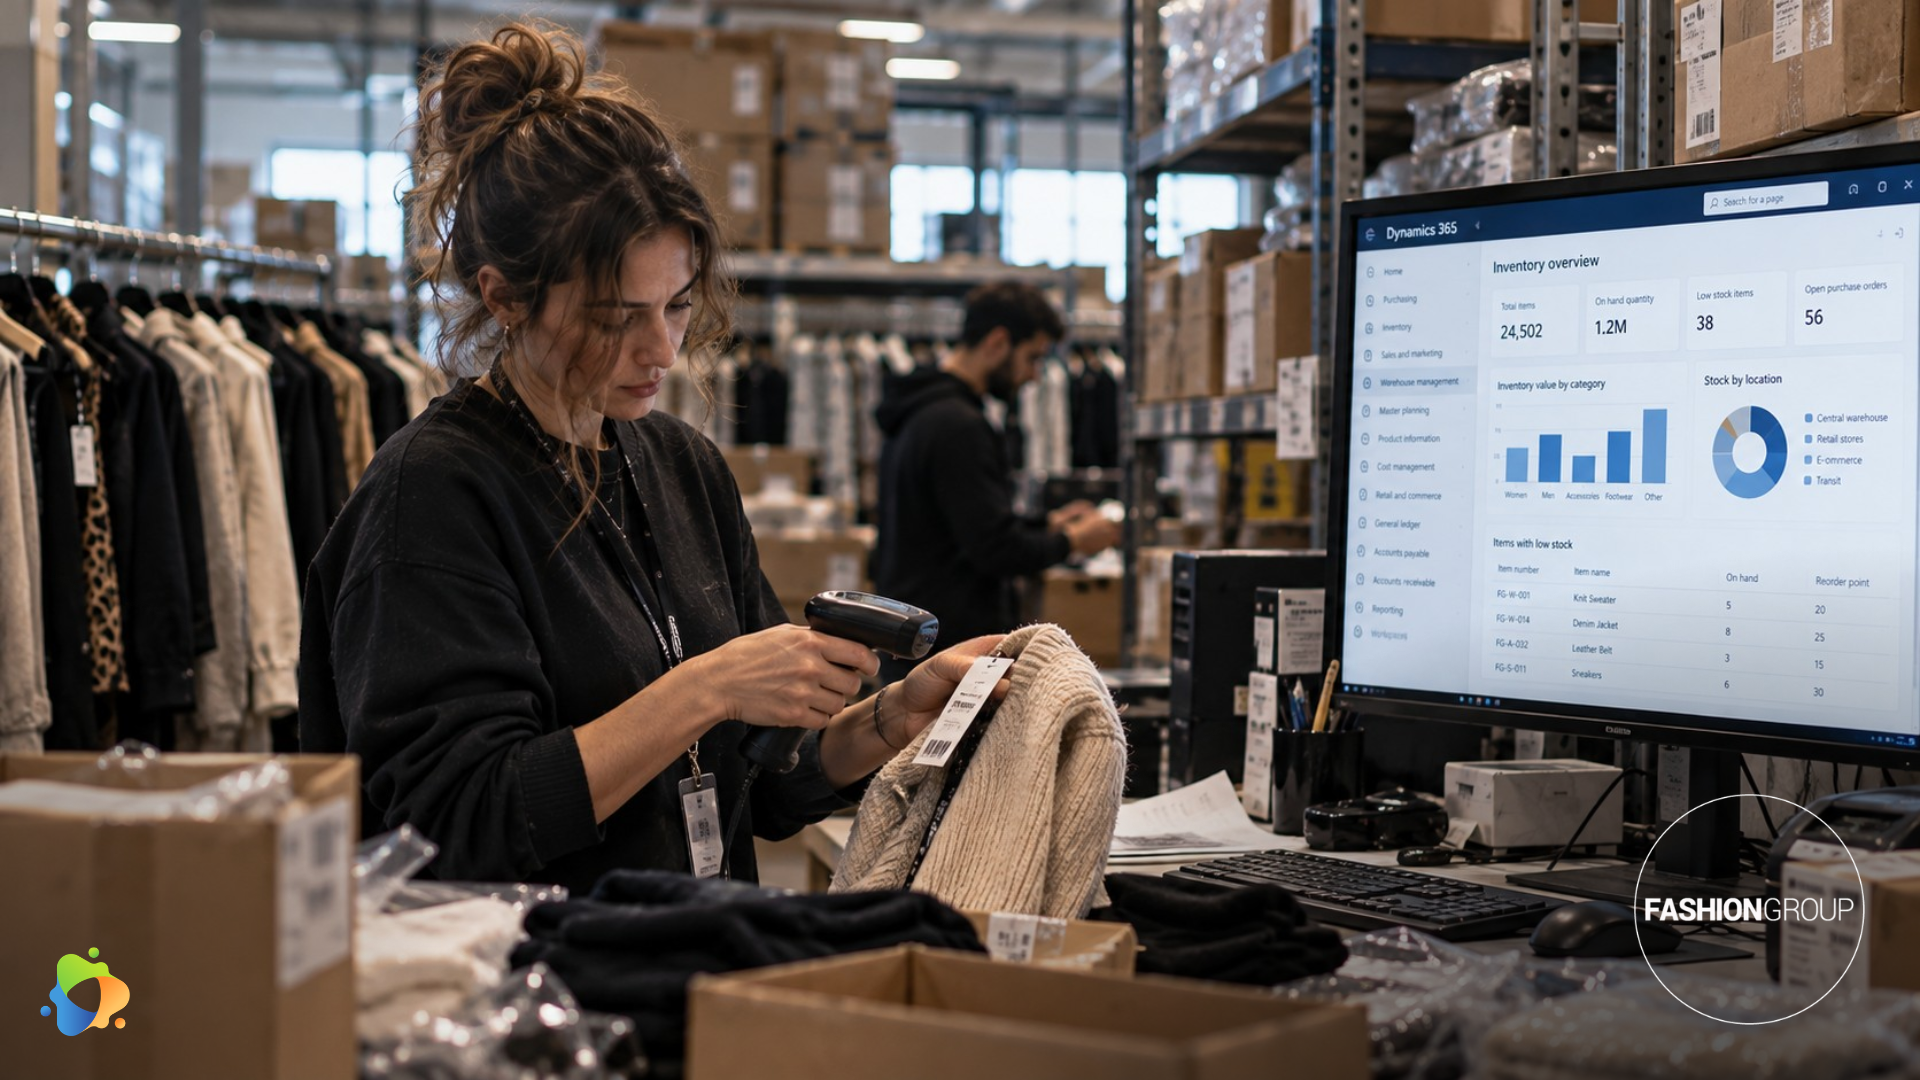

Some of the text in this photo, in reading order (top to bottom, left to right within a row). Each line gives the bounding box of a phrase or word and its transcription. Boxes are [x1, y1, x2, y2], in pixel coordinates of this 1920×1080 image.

[1748, 195, 1758, 205] for
[1765, 194, 1784, 205] page
[1386, 220, 1458, 242] Dynamics 365
[1492, 254, 1600, 274] Inventory overview
[1383, 267, 1403, 276] Home
[1804, 280, 1888, 295] Open purchase orders
[1382, 294, 1418, 305] Purchasing
[1696, 288, 1754, 300] Low stock items
[1594, 294, 1655, 306] On hand quantity
[1501, 301, 1536, 311] Total items
[1696, 314, 1714, 331] 38
[1804, 308, 1824, 326] 56
[1381, 323, 1413, 333] Inventory
[1500, 323, 1543, 341] 24,502
[1594, 319, 1628, 336] 1.2M
[1381, 348, 1443, 360] Sales and marketing
[1380, 377, 1459, 388] Warehouse management
[1497, 378, 1606, 392] Inventory value by category
[1703, 373, 1783, 387] Stock by location
[1401, 405, 1430, 417] planning
[1816, 412, 1889, 424] Central warehouse
[1378, 433, 1441, 443] Product information
[1816, 434, 1864, 444] Retail stores
[1377, 462, 1435, 474] Cost management
[1816, 475, 1842, 486] Transit
[1375, 490, 1442, 501] Retail and commerce
[1504, 491, 1528, 499] Women
[1541, 491, 1555, 499] Men
[1644, 492, 1663, 502] Other
[1374, 518, 1421, 531] General ledger
[1493, 537, 1573, 550] Items with low stock
[1374, 547, 1430, 560] Accounts payable
[1497, 564, 1540, 575] Item number
[1573, 567, 1611, 577] Item name
[1372, 575, 1402, 586] Accounts
[1726, 572, 1759, 583] On hand
[1815, 575, 1870, 588] Reorder point
[1496, 589, 1531, 600] FG-W-001
[1573, 593, 1588, 604] Knit
[1725, 600, 1732, 610] 5
[1814, 604, 1826, 615] 20
[1371, 604, 1404, 618] Reporting
[1572, 618, 1619, 630] Denim Jacket
[1725, 626, 1732, 637] 8
[1814, 632, 1826, 643] 25
[1571, 644, 1613, 655] Leather Belt
[1724, 653, 1731, 663] 3
[1494, 662, 1527, 673] FG-S-011
[1814, 659, 1825, 670] 15
[1571, 668, 1603, 680] Sneakers
[1724, 679, 1731, 689] 6
[1813, 687, 1825, 697] 30
